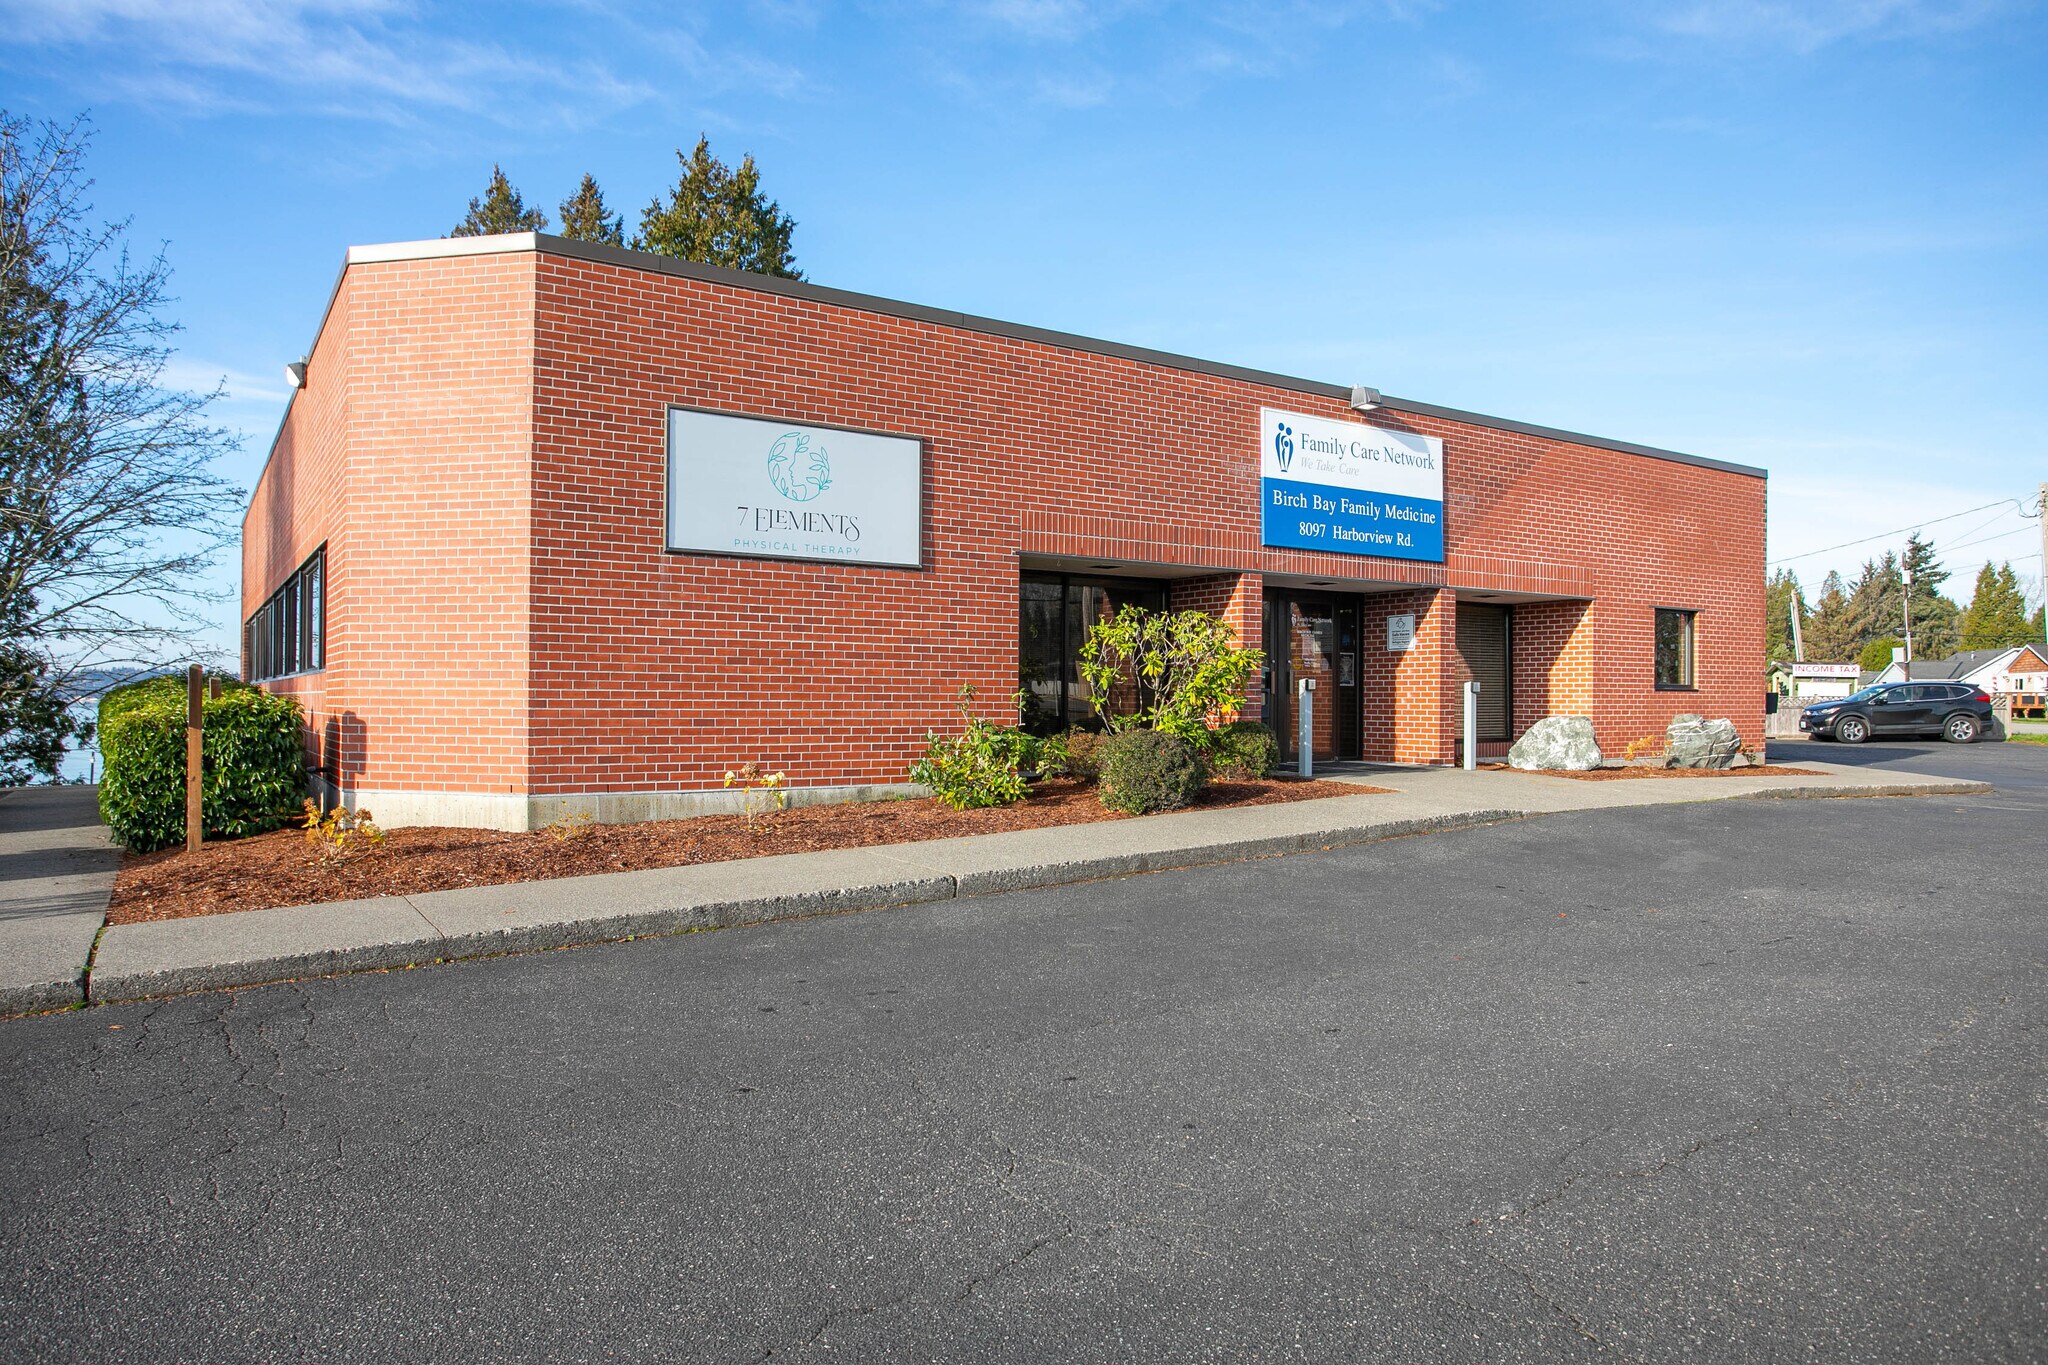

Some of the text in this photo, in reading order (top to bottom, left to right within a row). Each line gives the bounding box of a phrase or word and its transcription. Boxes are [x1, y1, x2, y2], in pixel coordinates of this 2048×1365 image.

[1301, 433, 1435, 470] Family Care Network
[1301, 457, 1360, 476] We Take Care
[1273, 489, 1436, 525] Birch Bay Family Medicine
[738, 506, 860, 542] 7 ELEMENTS
[1299, 521, 1414, 547] 8097 Harborview Rd.
[734, 539, 860, 556] PHYSICAL THERAPY
[1795, 665, 1835, 673] INCOME
